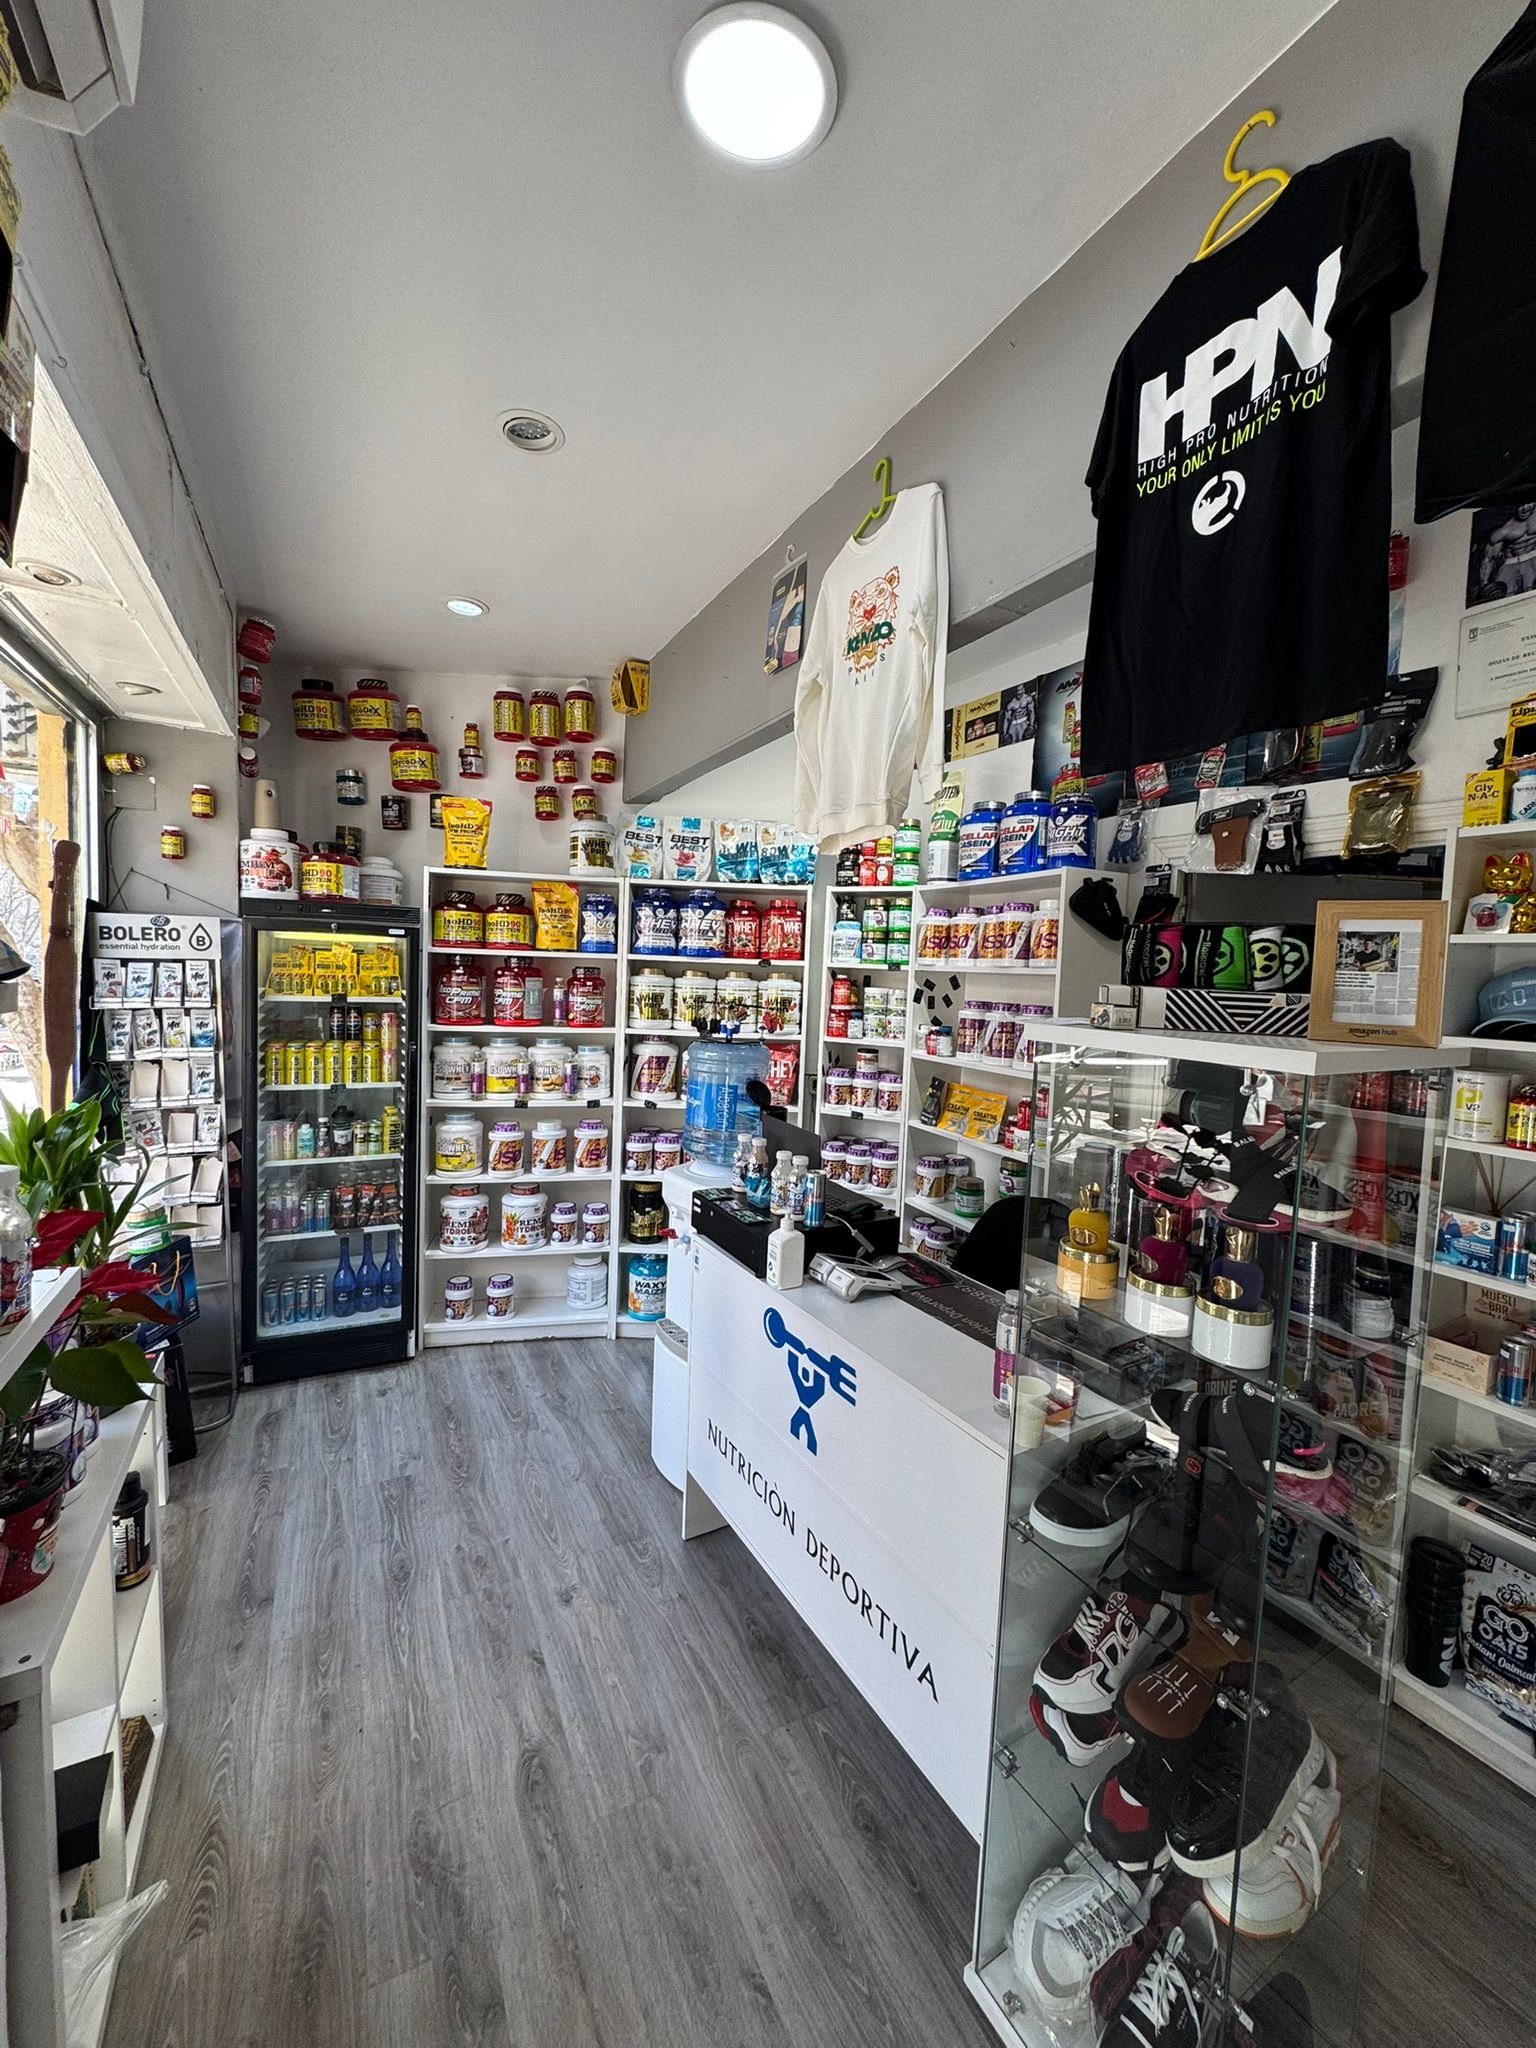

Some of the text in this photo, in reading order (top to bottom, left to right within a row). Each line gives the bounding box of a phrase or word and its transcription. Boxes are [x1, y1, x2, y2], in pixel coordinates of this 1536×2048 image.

[1137, 245, 1343, 464] HPN
[1137, 355, 1329, 478] HIGH PRO NUTRITION
[1136, 465, 1177, 498] YOUR
[1181, 441, 1217, 478] ONLY
[1289, 378, 1326, 413] YOU
[847, 621, 894, 656] KENZO
[316, 705, 328, 714] 90
[1474, 784, 1493, 793] Gly
[1467, 790, 1500, 801] N-A-C
[625, 831, 663, 843] BEST
[670, 834, 710, 845] BEST
[585, 839, 610, 849] WHEY
[669, 844, 709, 853] WHEY
[591, 847, 607, 856] PRO
[319, 869, 332, 878] 90
[443, 917, 472, 926] IsoHD
[510, 920, 521, 928] 90
[681, 919, 720, 930] WHEY
[734, 920, 756, 934] WHEY
[99, 925, 181, 941] BOLERO
[140, 943, 181, 951] hydration
[1199, 941, 1211, 976] BARROW
[639, 993, 665, 1003] WHEY
[767, 997, 792, 1007] WHEY
[1348, 1027, 1398, 1036] amazon hub
[769, 1060, 797, 1078] HEY
[1465, 1103, 1480, 1111] V2
[389, 1123, 400, 1151] PRIME
[635, 1280, 667, 1290] WAXY
[1481, 1287, 1517, 1307] MUESLI
[1488, 1301, 1509, 1316] BAR
[1480, 1552, 1493, 1567] 20
[806, 1527, 939, 1704] DEPORTIVA
[1483, 1605, 1529, 1643] GO
[1479, 1622, 1529, 1661] OATS
